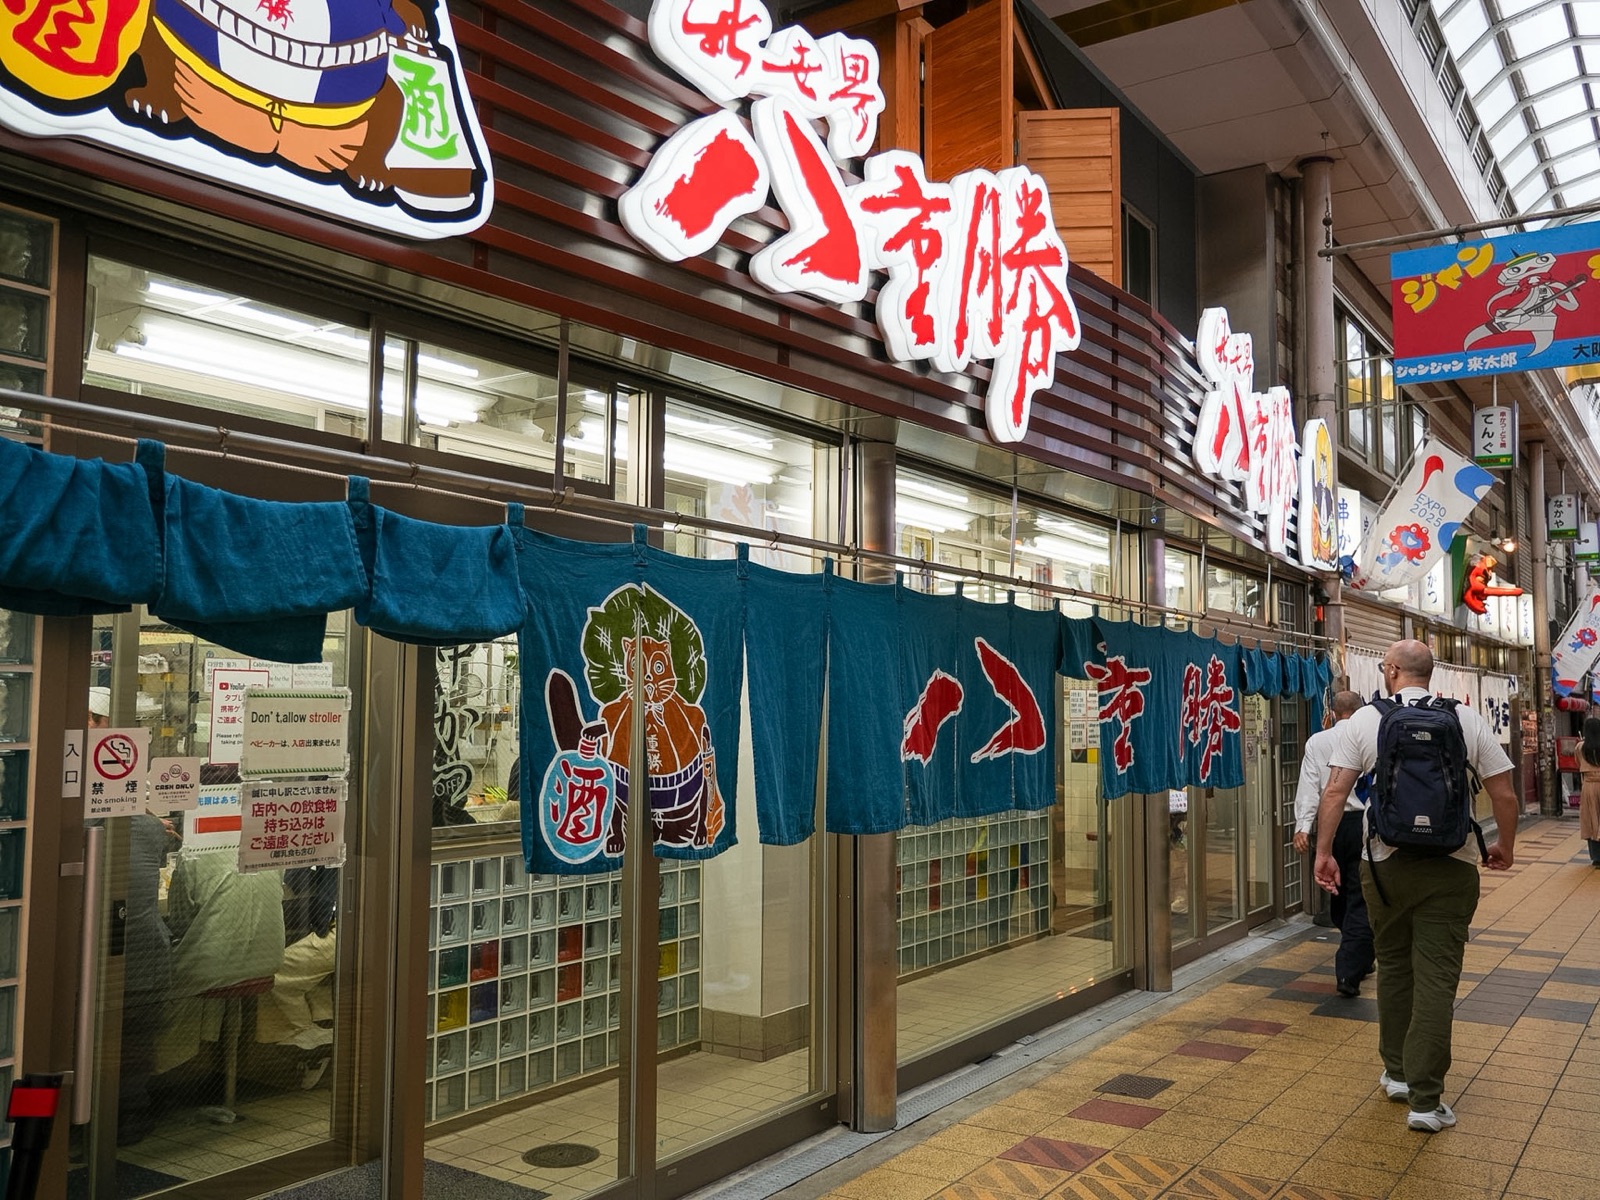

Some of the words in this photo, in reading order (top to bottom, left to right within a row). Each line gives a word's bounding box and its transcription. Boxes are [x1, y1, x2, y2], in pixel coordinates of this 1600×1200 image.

[654, 110, 1076, 428] 八重勝
[1401, 242, 1495, 313] ジャン
[1396, 360, 1464, 379] ジャンジャン
[1467, 352, 1518, 372] 来太郎
[1481, 413, 1495, 454] てんぐ
[1409, 503, 1443, 528] 2025
[1416, 493, 1447, 518] EXPO
[1553, 500, 1565, 528] なかや
[309, 711, 342, 723] stroller
[901, 637, 1241, 783] 八重勝
[65, 743, 80, 784] 入口
[91, 781, 138, 795] 禁煙
[91, 797, 103, 805] No
[104, 796, 137, 804] smoking
[252, 786, 337, 798] 誠に申し訳ございません
[251, 799, 337, 817] 店内への飲食物
[551, 759, 608, 845] 酒
[264, 817, 325, 833] 持ち込みは
[250, 832, 335, 850] ご遠慮ください
